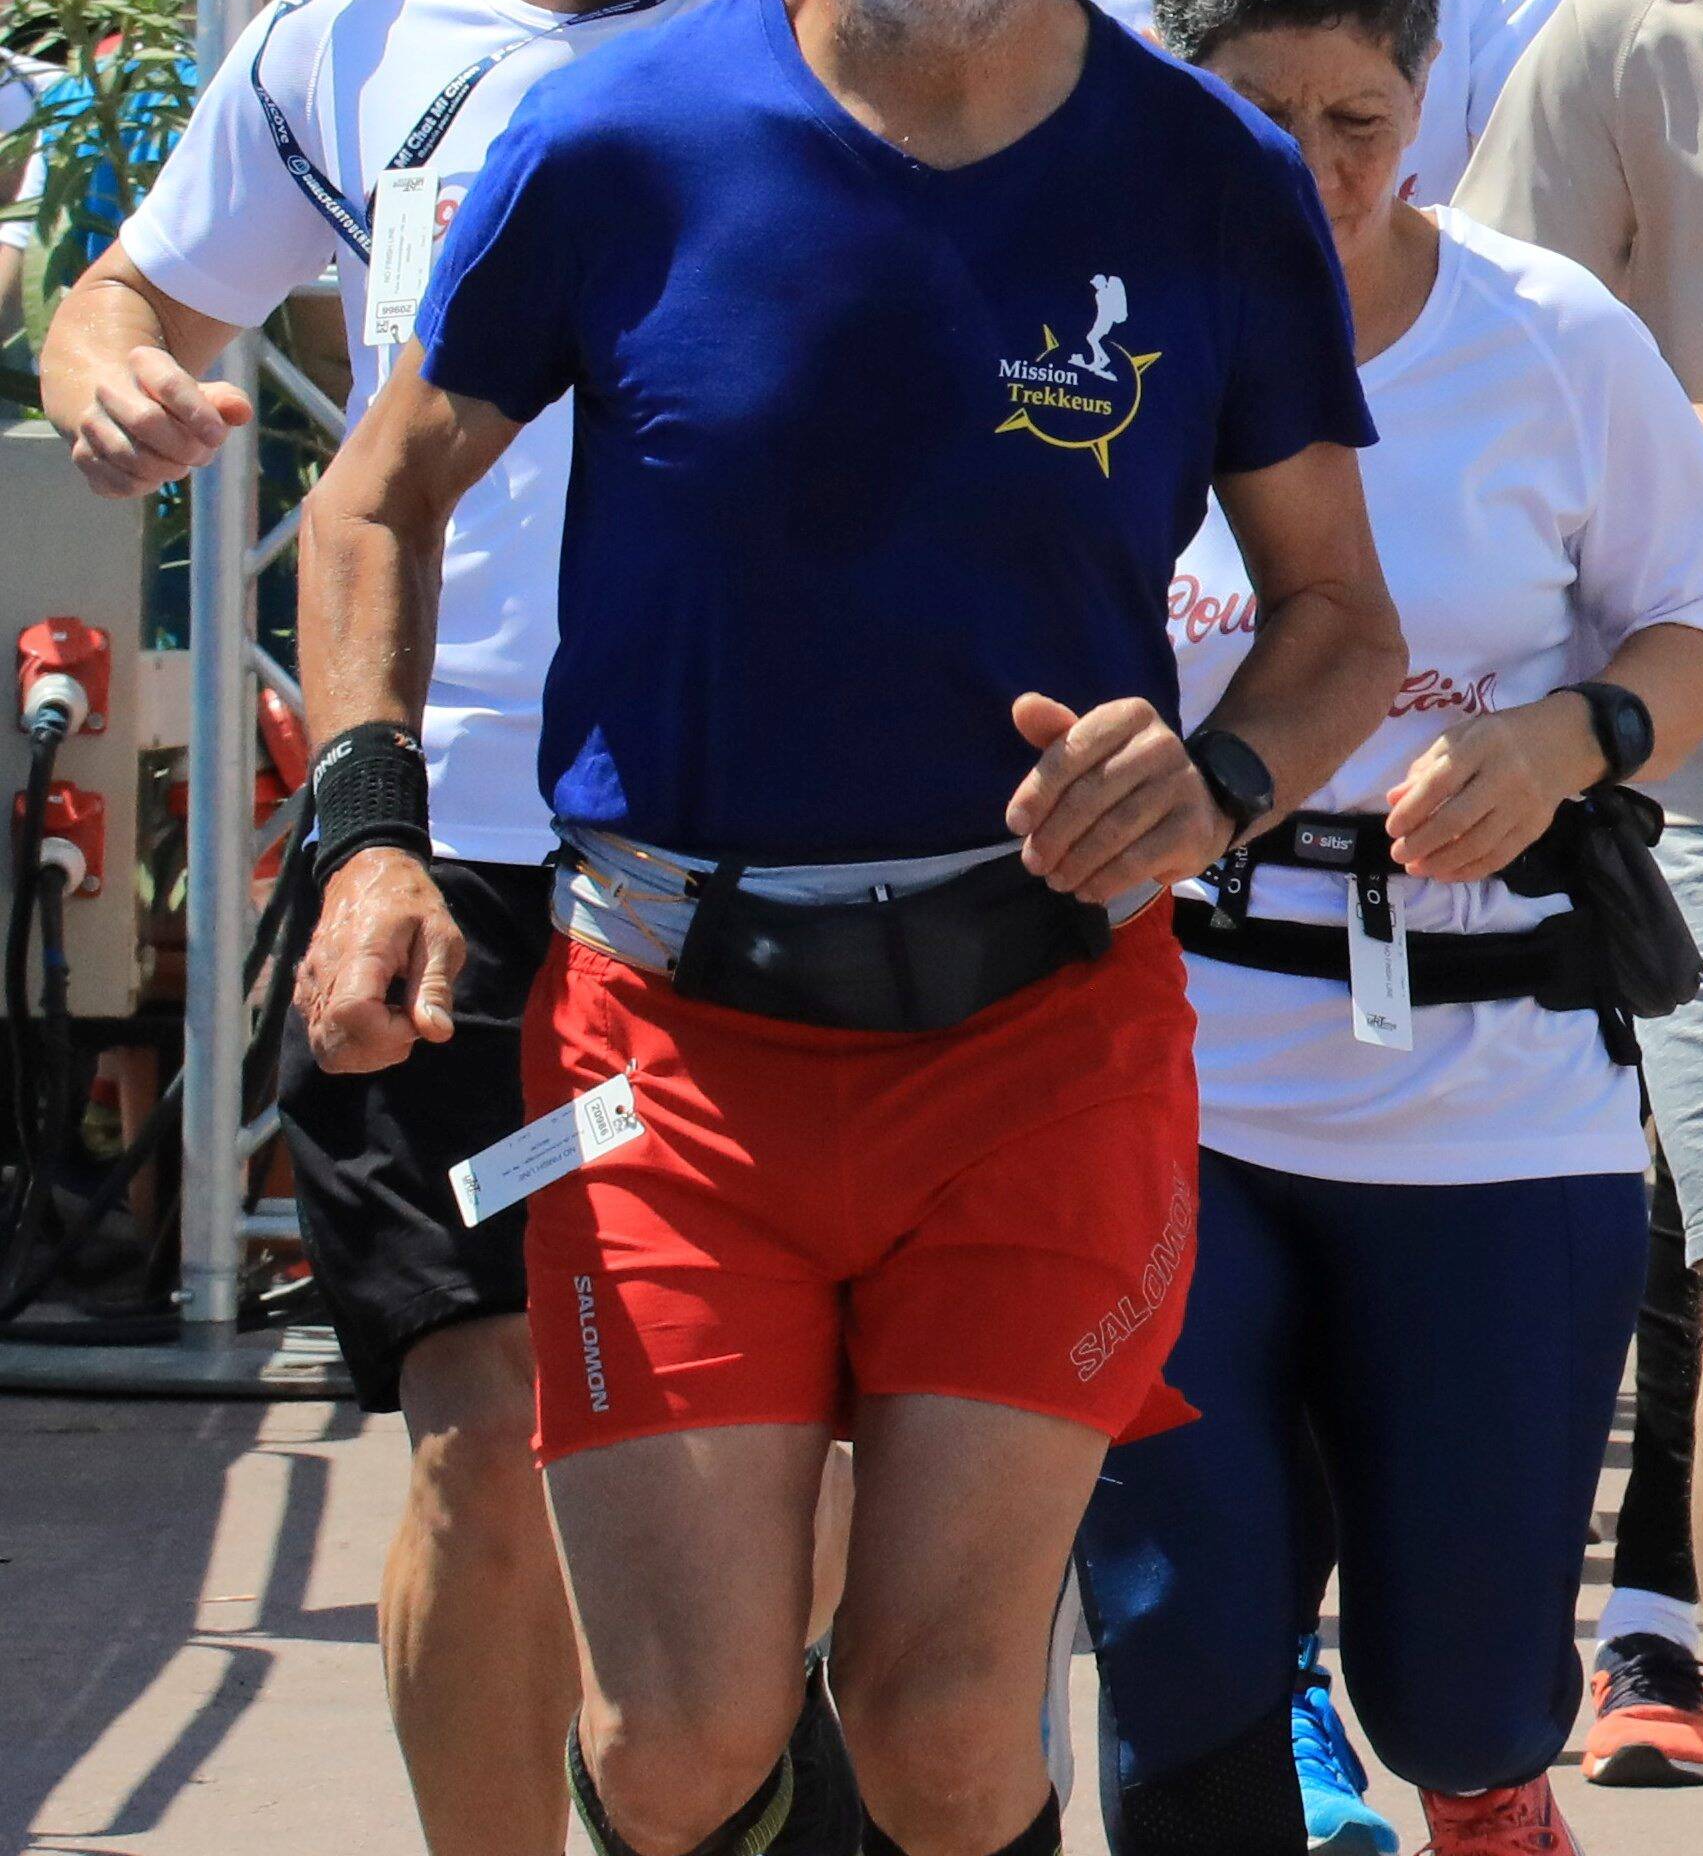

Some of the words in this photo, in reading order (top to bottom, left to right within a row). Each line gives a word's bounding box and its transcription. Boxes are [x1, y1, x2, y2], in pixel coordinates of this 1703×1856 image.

[406, 117, 438, 151] Chat
[999, 359, 1079, 386] Mission
[1007, 382, 1112, 415] Trekkeurs
[573, 1275, 610, 1412] SALOMON
